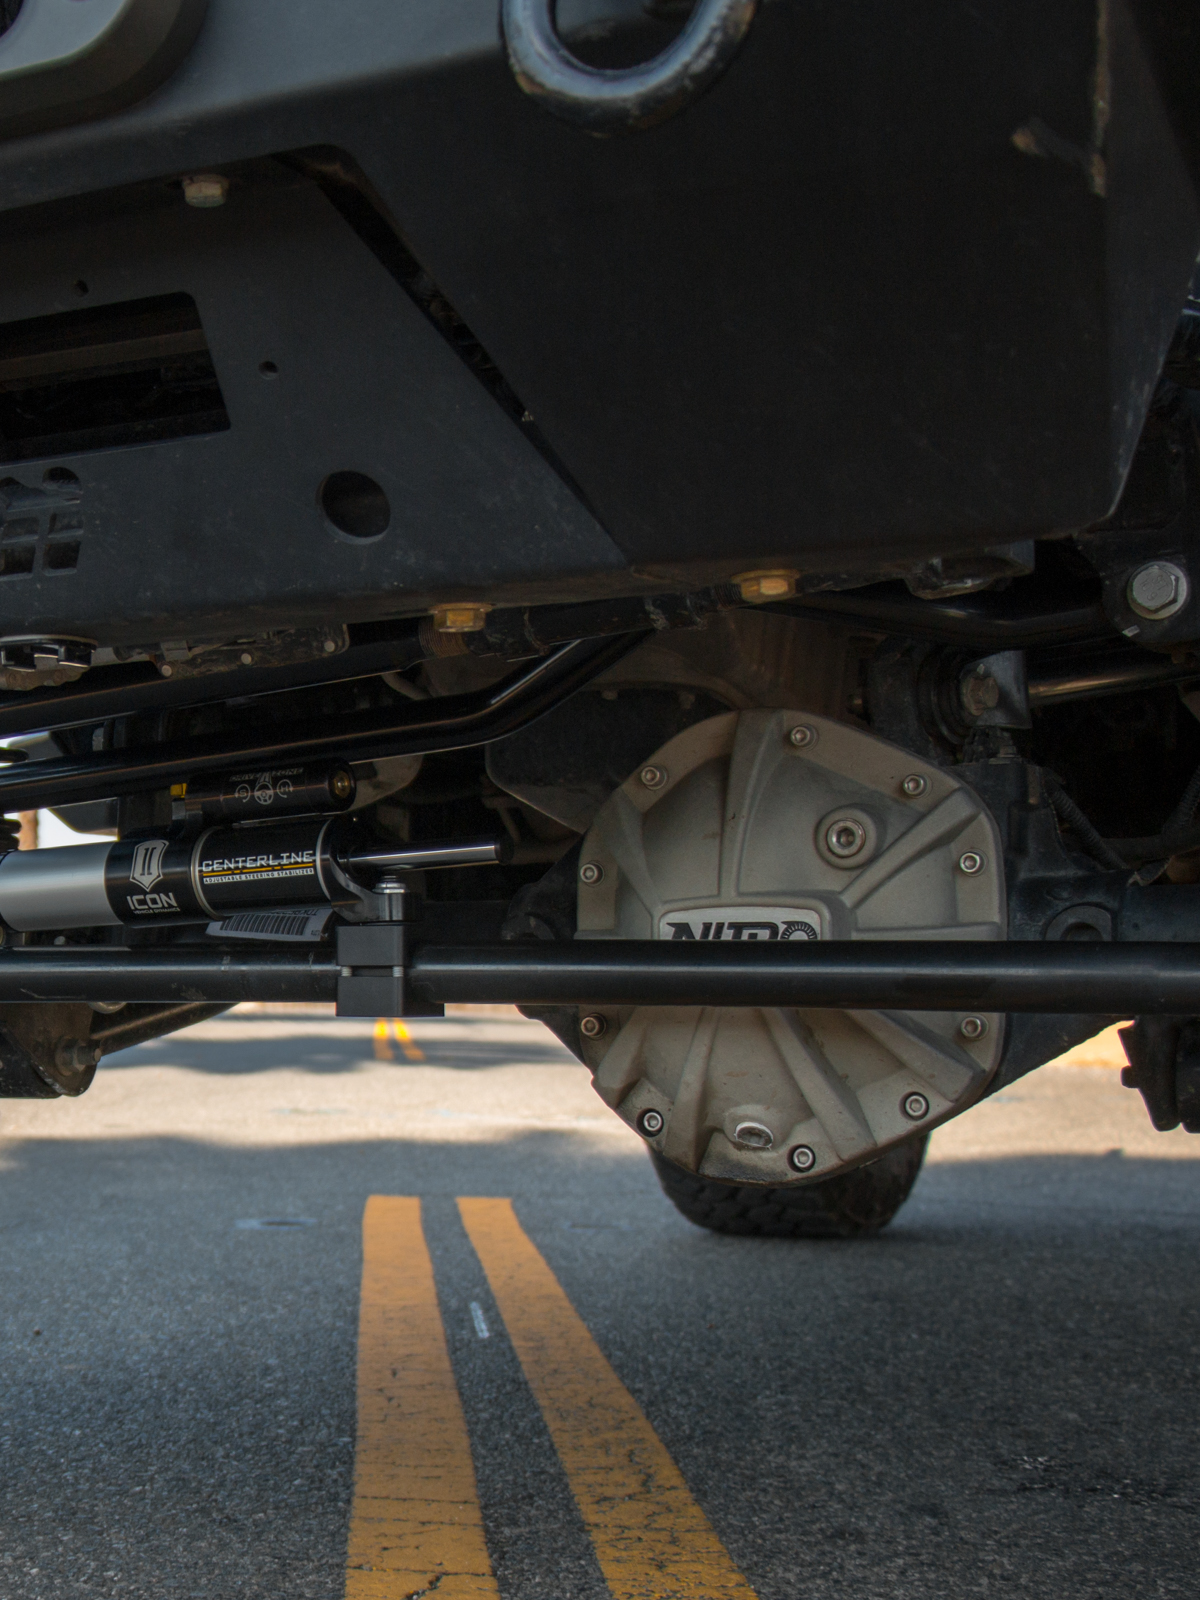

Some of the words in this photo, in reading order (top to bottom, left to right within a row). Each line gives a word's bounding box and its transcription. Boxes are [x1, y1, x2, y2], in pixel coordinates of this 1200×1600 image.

[202, 850, 314, 872] CENTERLINE
[204, 875, 242, 883] ADJUSTABLE
[126, 892, 178, 910] ICON
